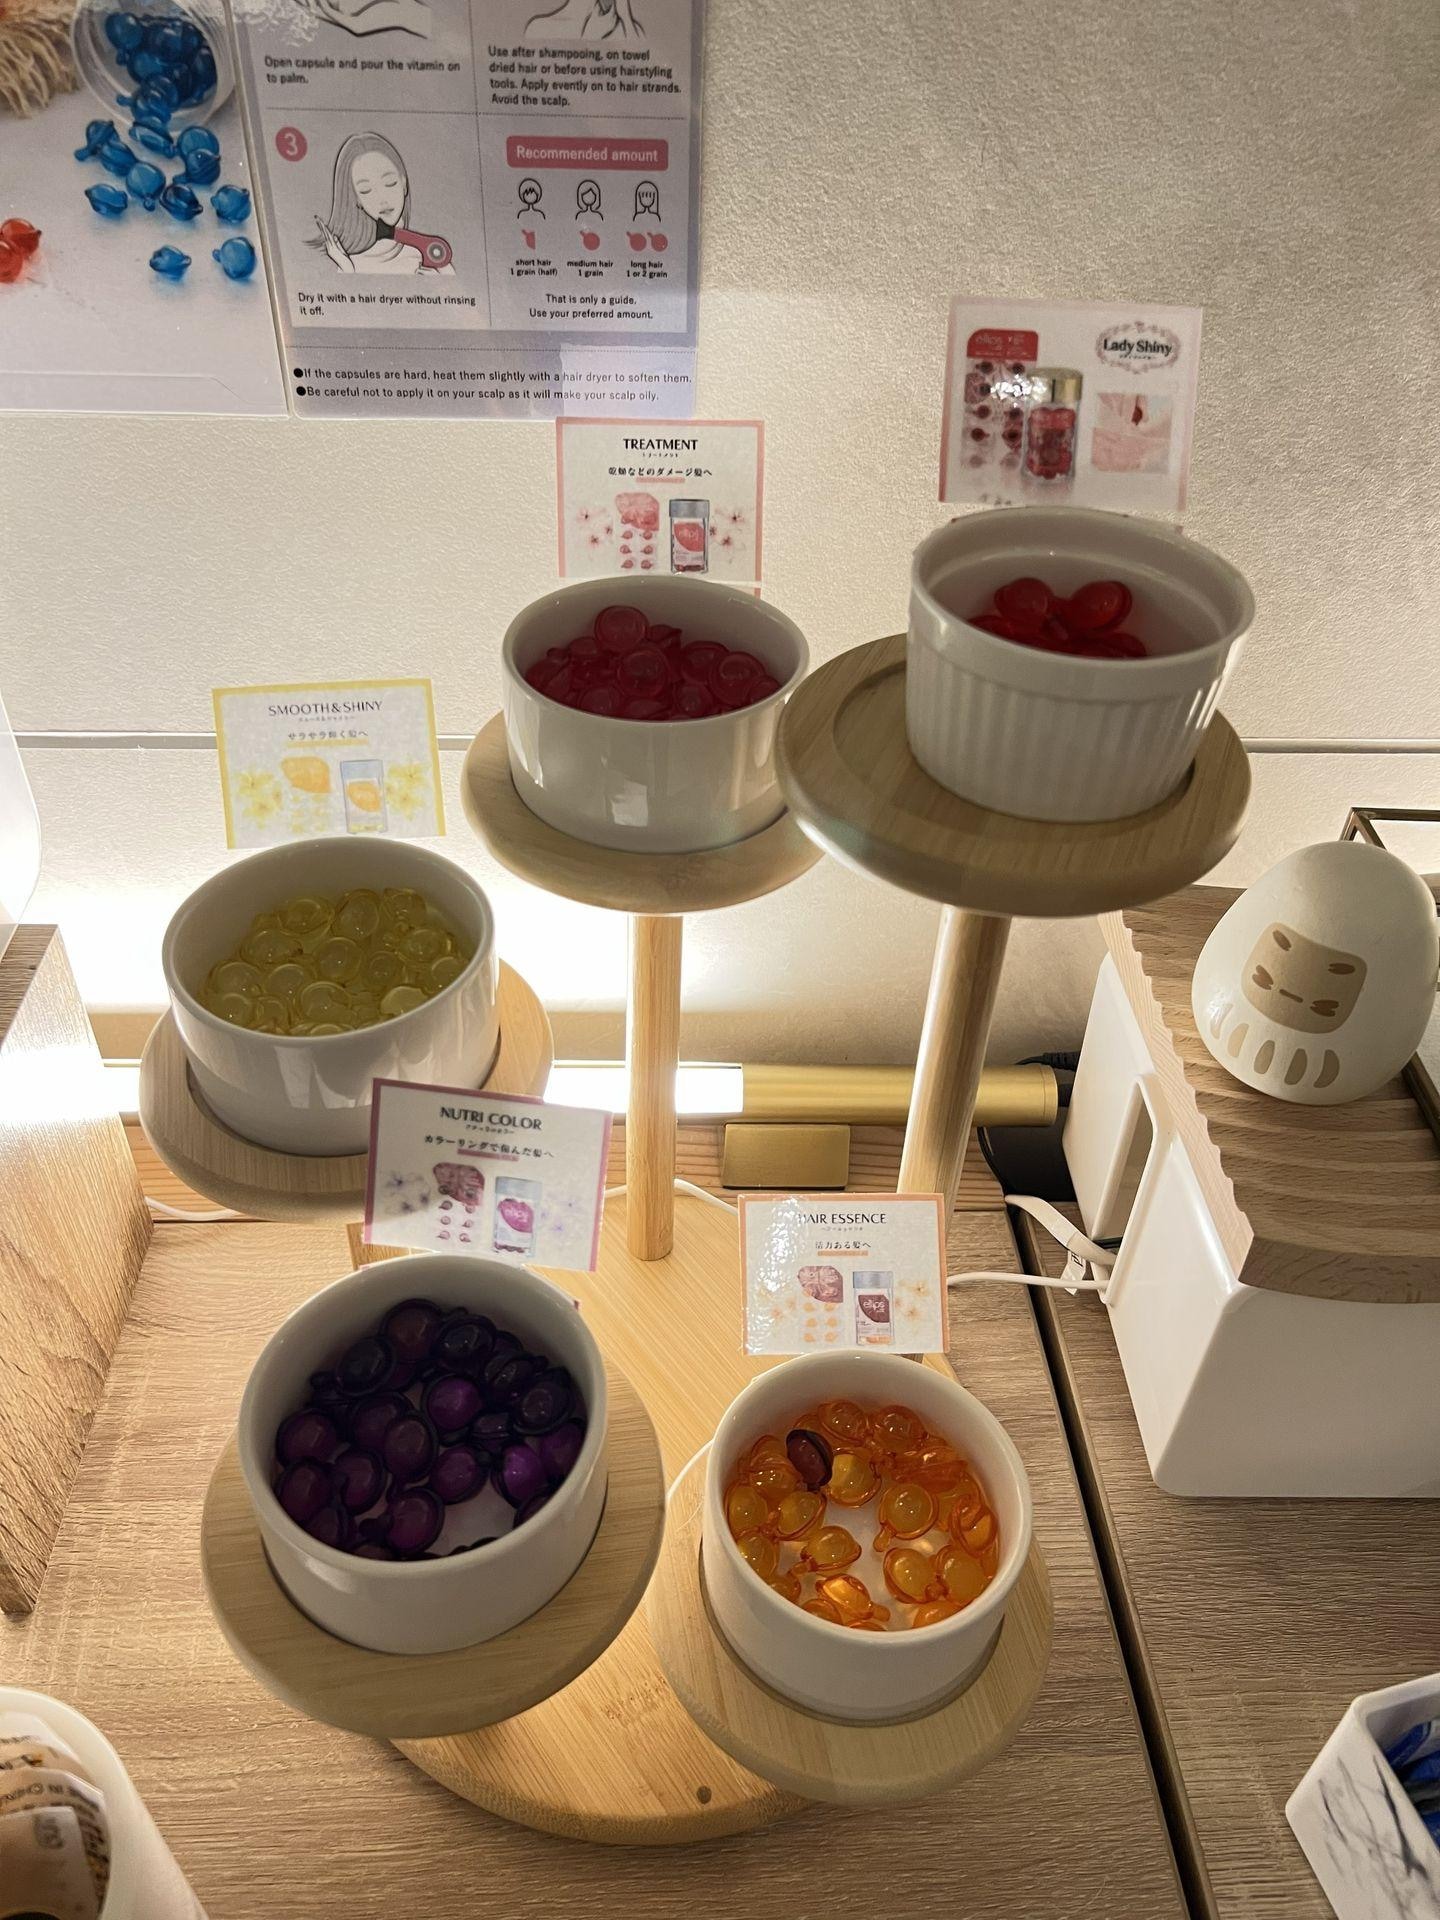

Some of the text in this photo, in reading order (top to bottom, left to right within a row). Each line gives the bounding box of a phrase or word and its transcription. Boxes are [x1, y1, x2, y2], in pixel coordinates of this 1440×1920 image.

[489, 46, 508, 57] Use
[512, 47, 535, 57] after
[606, 51, 618, 59] on
[623, 50, 650, 60] towel
[265, 56, 460, 71] Open capsule and pour the vitamin on
[490, 62, 672, 78] dried hair or before using hairstyling
[267, 73, 308, 84] to palm.
[490, 79, 681, 93] tools. Apply evently on to hair strands.
[492, 94, 570, 106] Avoid the scalp.
[284, 133, 296, 154] 3
[517, 146, 657, 162] Recommended amount
[631, 261, 646, 269] long
[585, 270, 603, 278] grain
[649, 271, 667, 279] grain
[299, 293, 314, 303] Dry
[318, 293, 324, 302] it
[327, 294, 347, 302] with
[359, 294, 376, 303] hair
[380, 295, 402, 305] dryer
[406, 295, 441, 304] without
[444, 296, 476, 306] rinsing
[546, 294, 566, 304] That
[569, 294, 576, 304] is
[580, 295, 598, 306] only
[610, 295, 636, 306] guide.
[300, 306, 324, 315] it off.
[530, 308, 653, 319] Use your preferred amount.
[1104, 338, 1172, 358] Lady Shiny
[315, 370, 331, 378] the
[335, 370, 380, 380] capsules
[404, 370, 430, 380] hard,
[434, 370, 456, 379] heat
[460, 371, 485, 380] them
[489, 371, 525, 382] slightly
[529, 372, 550, 381] with
[563, 372, 582, 382] hair
[586, 372, 611, 383] dryer
[616, 373, 625, 382] to
[629, 373, 660, 382] soften
[307, 387, 320, 396] Be
[324, 387, 359, 397] careful
[363, 388, 380, 397] not
[383, 388, 393, 397] to
[397, 388, 423, 399] apply
[427, 388, 434, 397] it
[453, 390, 475, 399] your
[479, 389, 505, 400] scalp
[508, 391, 520, 399] as
[524, 390, 530, 399] it
[534, 390, 550, 399] will
[554, 390, 580, 399] make
[585, 392, 605, 400] your
[609, 390, 636, 400] scalp
[639, 391, 659, 401] oily.
[623, 438, 698, 450] TREATMENT
[268, 700, 382, 716] SMOOTH&SHINY
[440, 1107, 484, 1123] NUTRI
[489, 1113, 542, 1130] COLOR
[832, 1214, 886, 1224] ESSENCE
